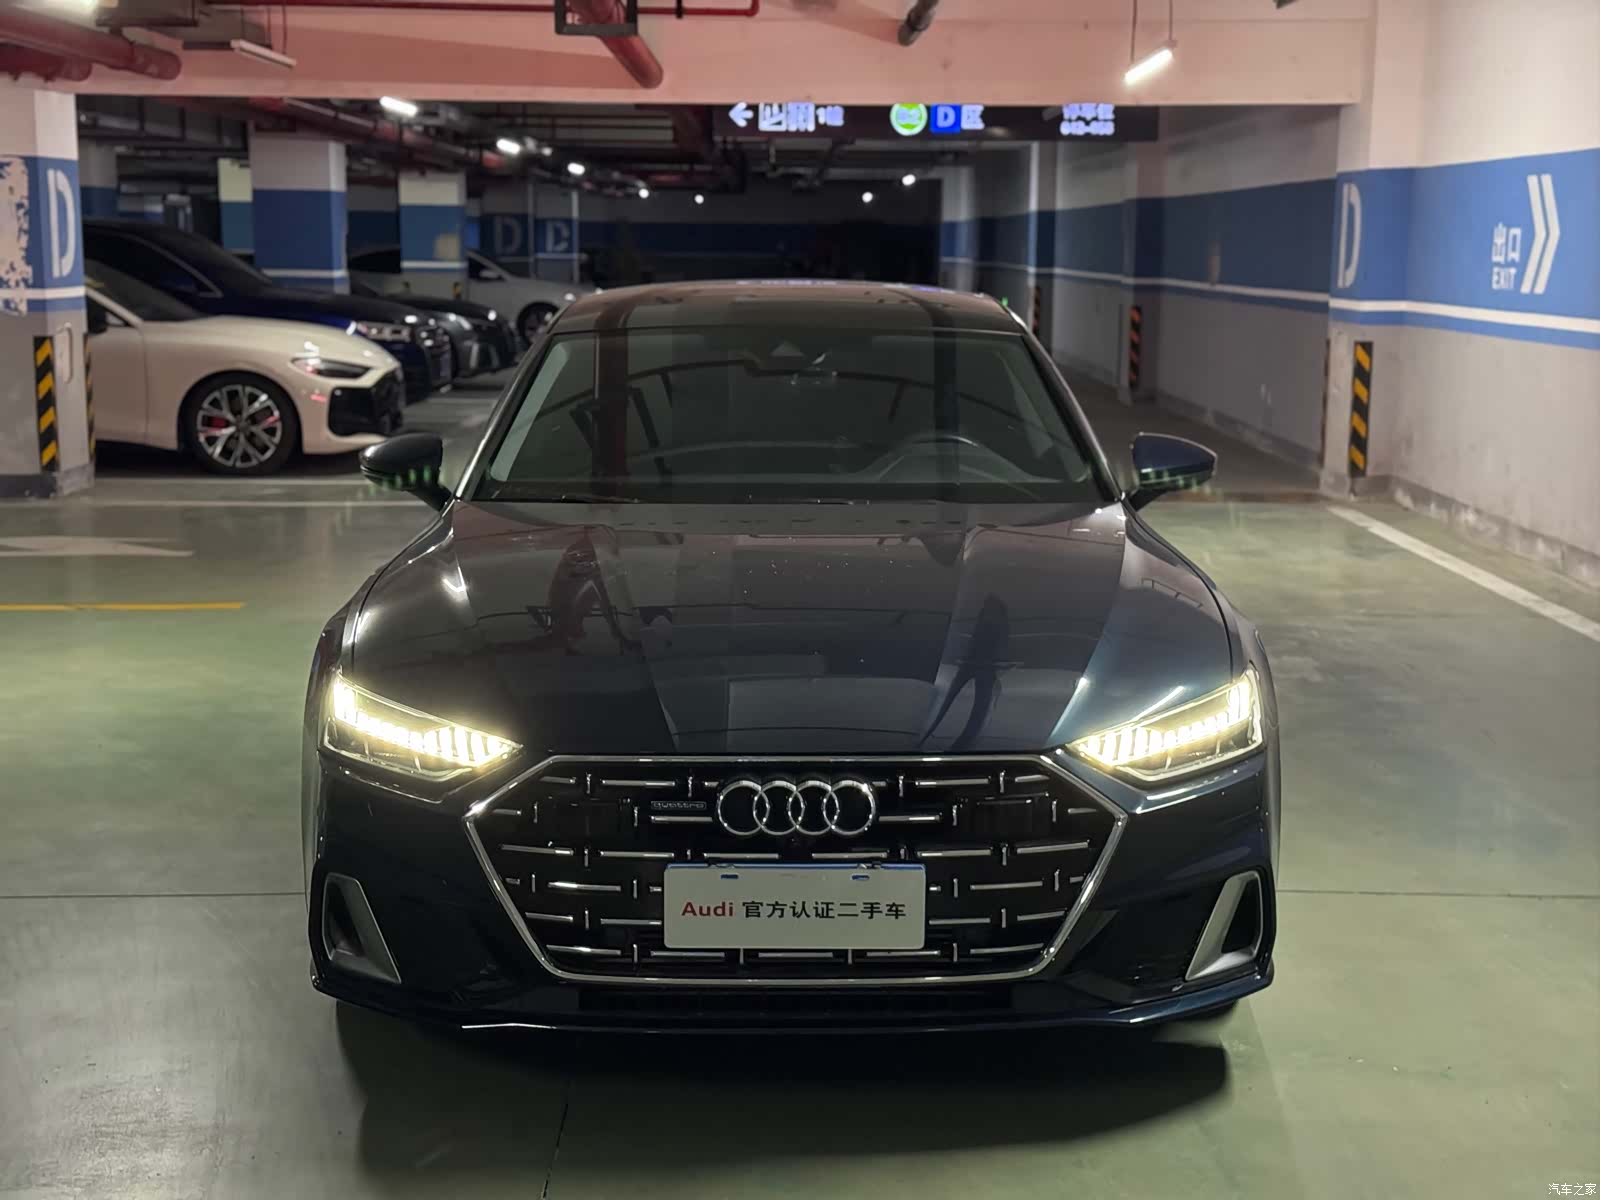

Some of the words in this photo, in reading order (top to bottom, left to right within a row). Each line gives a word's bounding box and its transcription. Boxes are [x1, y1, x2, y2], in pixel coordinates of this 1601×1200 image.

[47, 168, 76, 278] D
[1337, 182, 1361, 288] D
[1492, 222, 1522, 264] 出口
[1492, 266, 1517, 290] EXIT
[681, 901, 734, 917] Audi
[742, 901, 906, 919] 官方认证二手车
